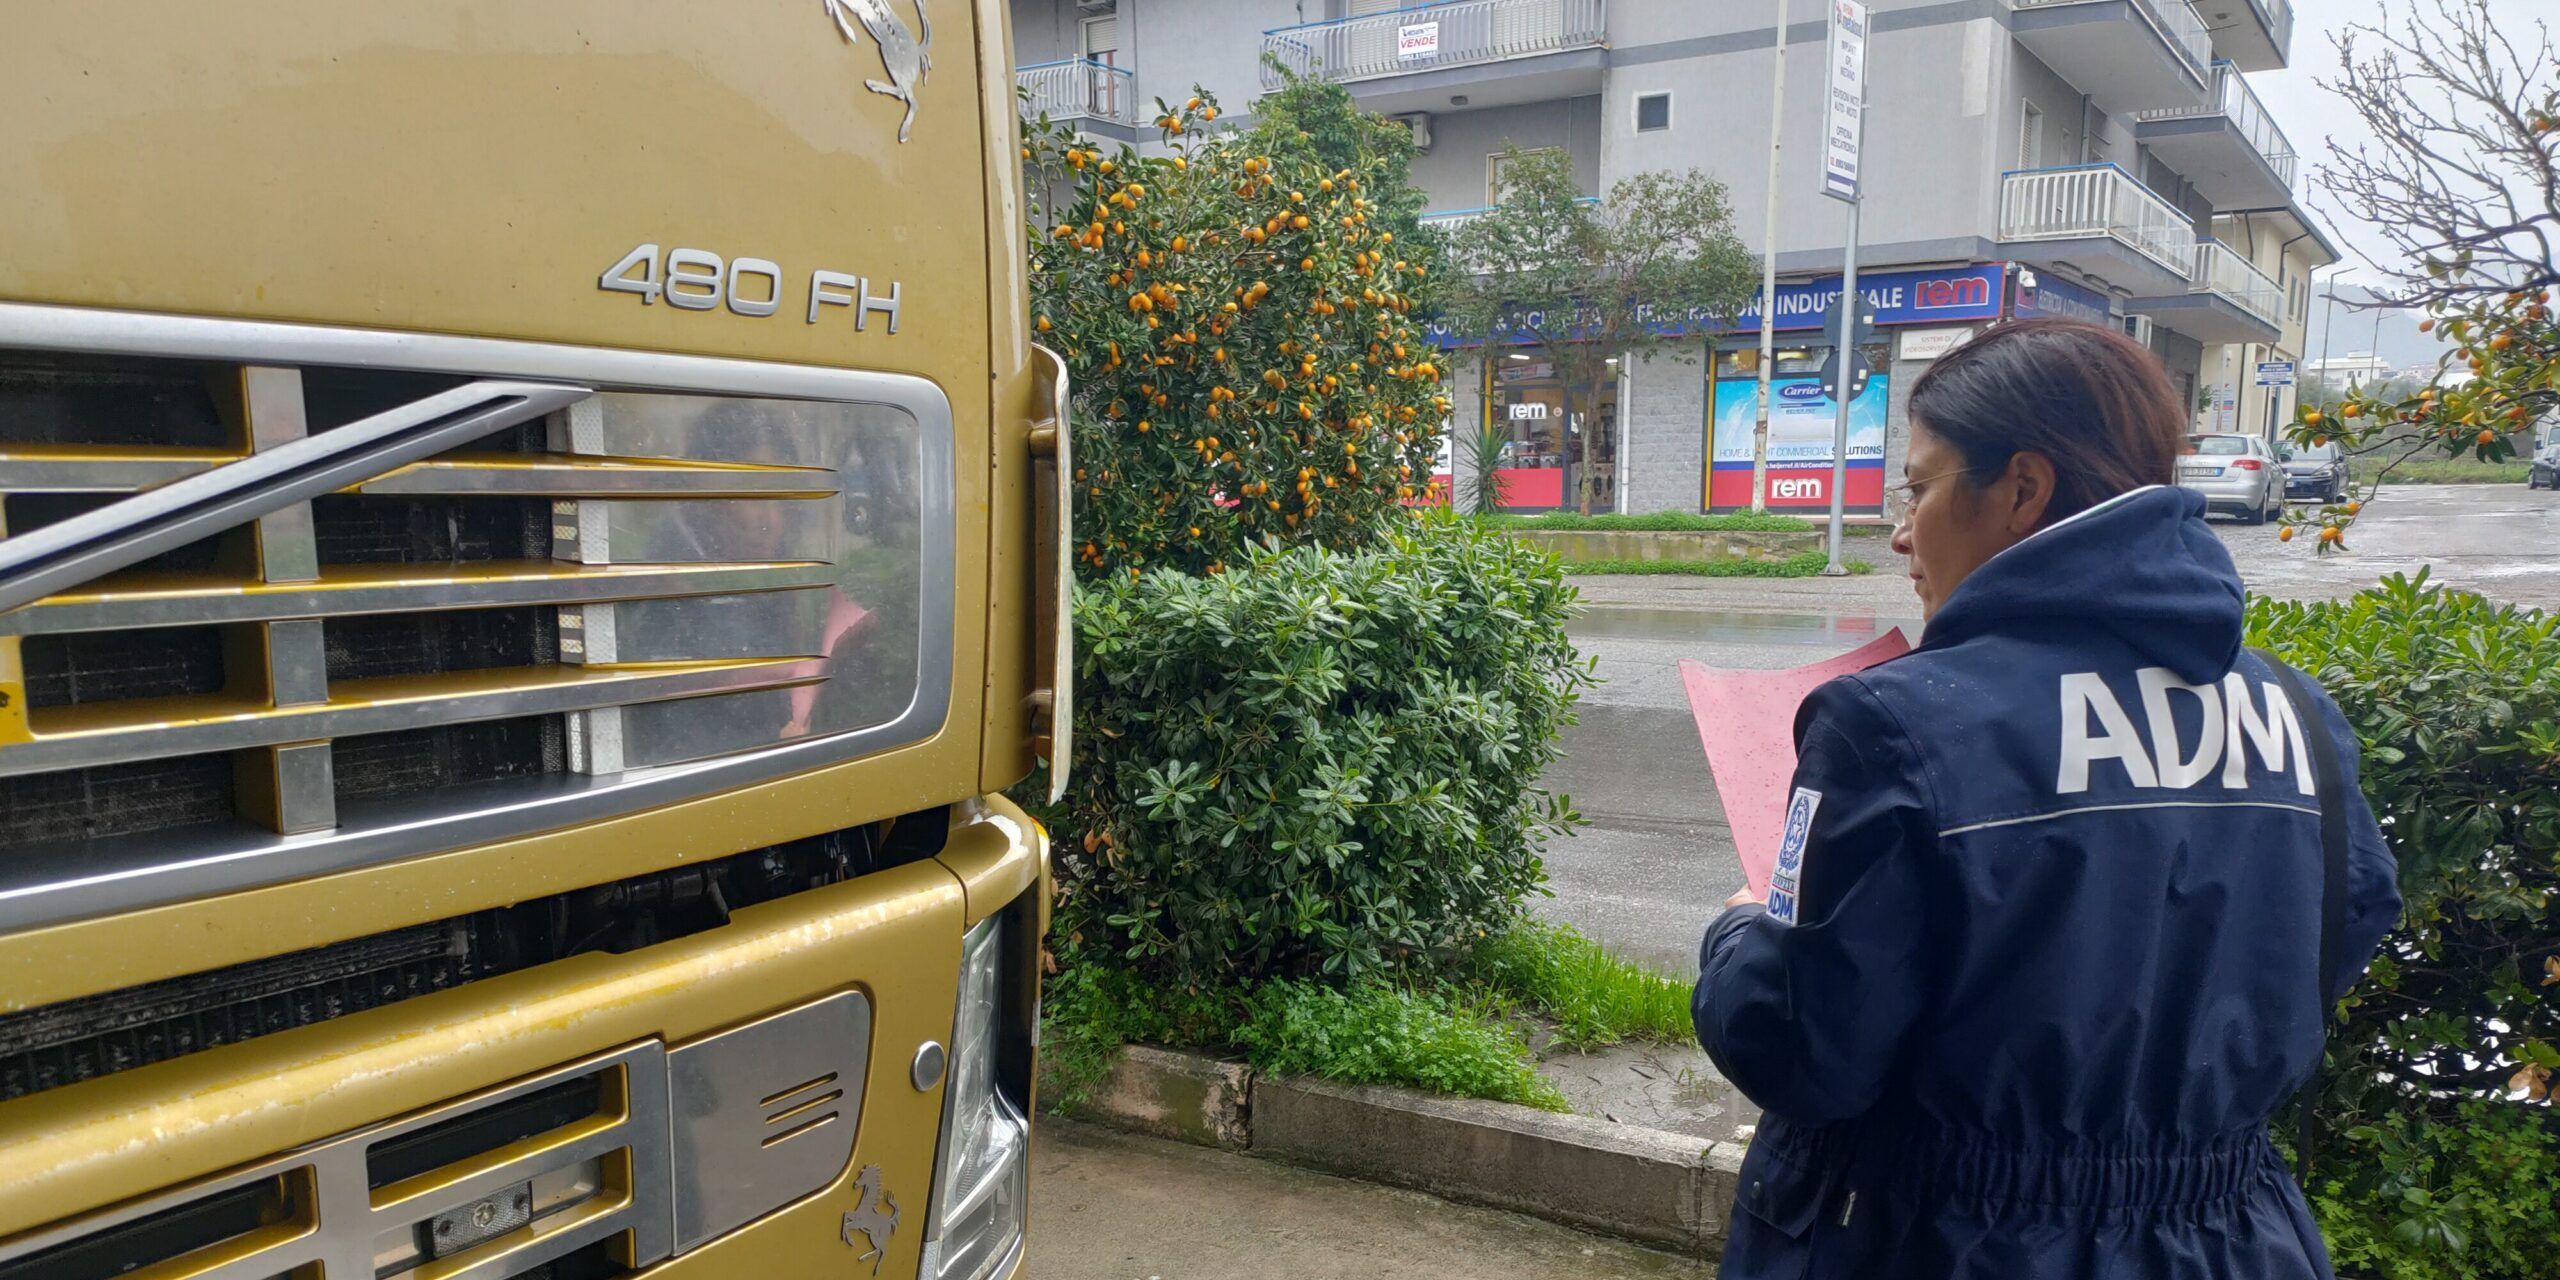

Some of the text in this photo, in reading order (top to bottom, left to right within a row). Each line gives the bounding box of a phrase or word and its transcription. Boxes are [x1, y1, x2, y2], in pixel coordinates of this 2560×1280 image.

[1401, 36, 1436, 48] VENDE
[598, 243, 901, 334] 480 FH
[1777, 287, 1903, 315] INDUSALE
[1915, 277, 1989, 309] rem
[1783, 386, 1822, 396] Carrier
[1509, 402, 1547, 419] rem
[1719, 449, 1743, 458] HOME
[1776, 446, 1830, 457] COMMERCIAL
[1831, 445, 1882, 456] SLUTIONS
[1771, 477, 1822, 499] rem
[2056, 666, 2315, 796] ADM
[1768, 889, 1793, 921] ADM
